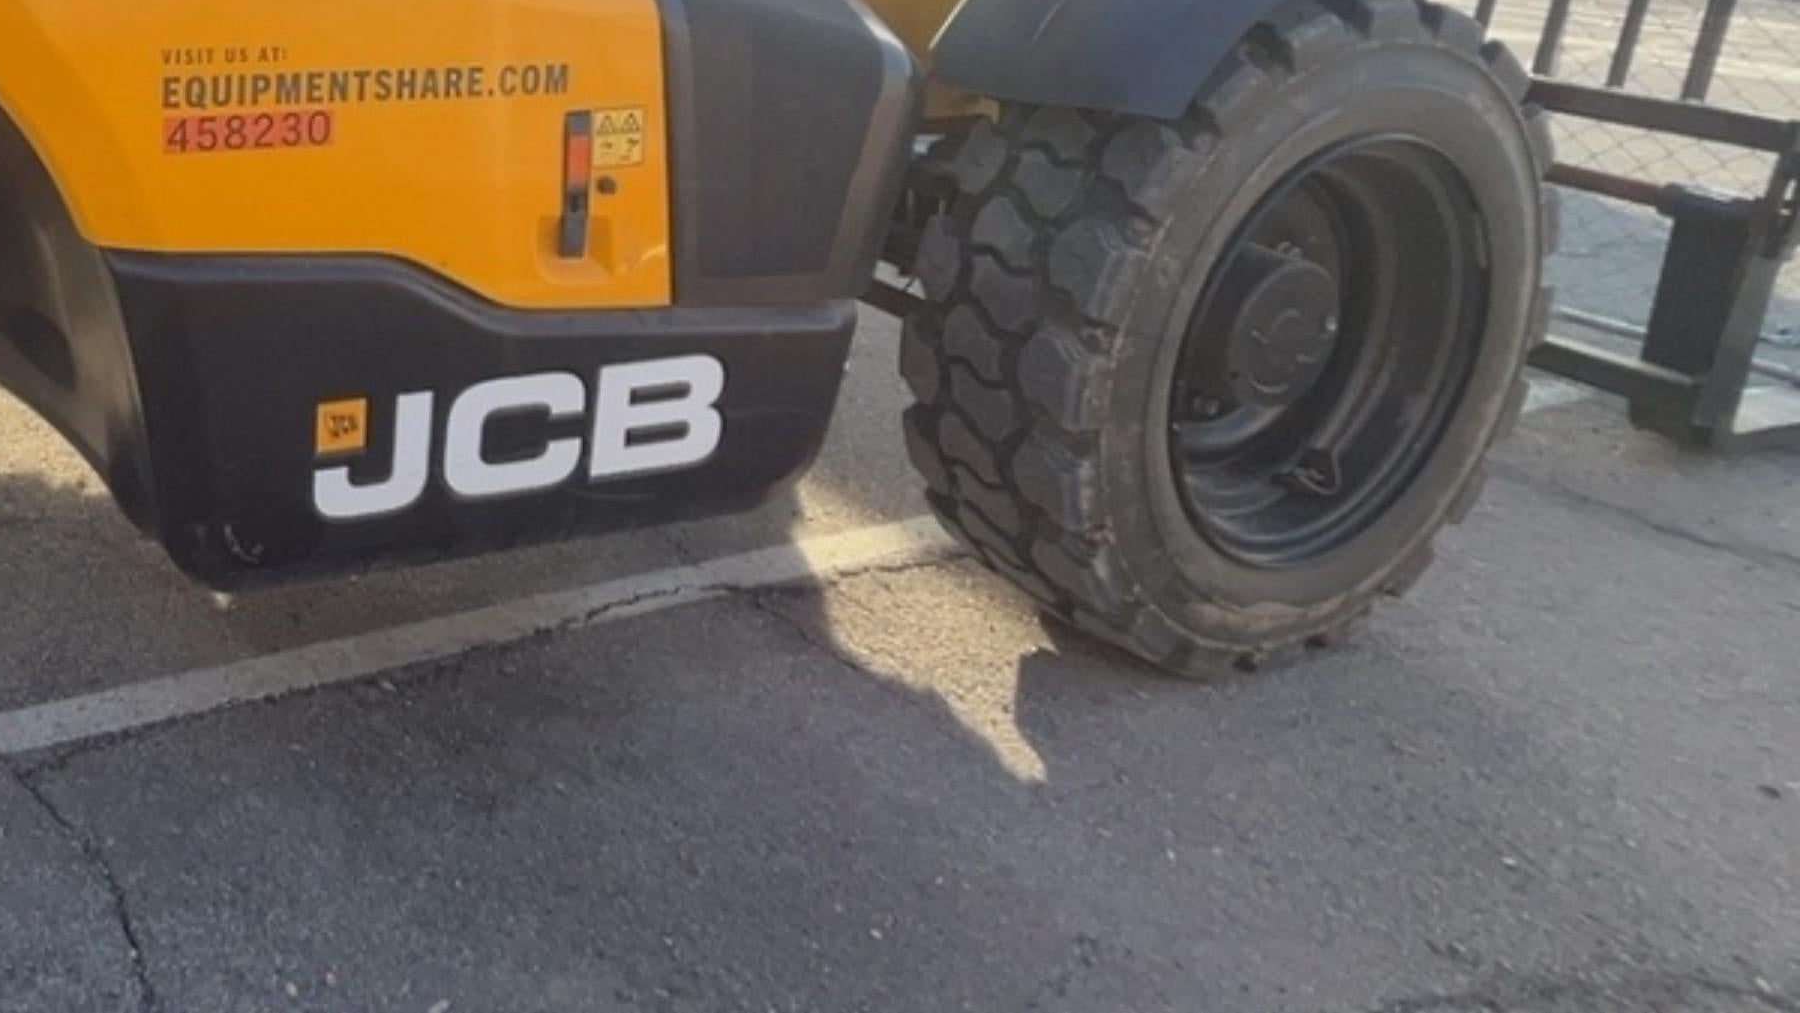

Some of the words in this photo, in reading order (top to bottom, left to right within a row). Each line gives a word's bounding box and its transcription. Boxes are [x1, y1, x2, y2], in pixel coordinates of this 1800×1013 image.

[162, 49, 214, 65] VISIT
[224, 48, 248, 63] US
[258, 46, 287, 62] AT:
[162, 64, 569, 109] EQUIPMENTSHARE.COM
[167, 110, 332, 153] 458230
[313, 354, 724, 519] JCB
